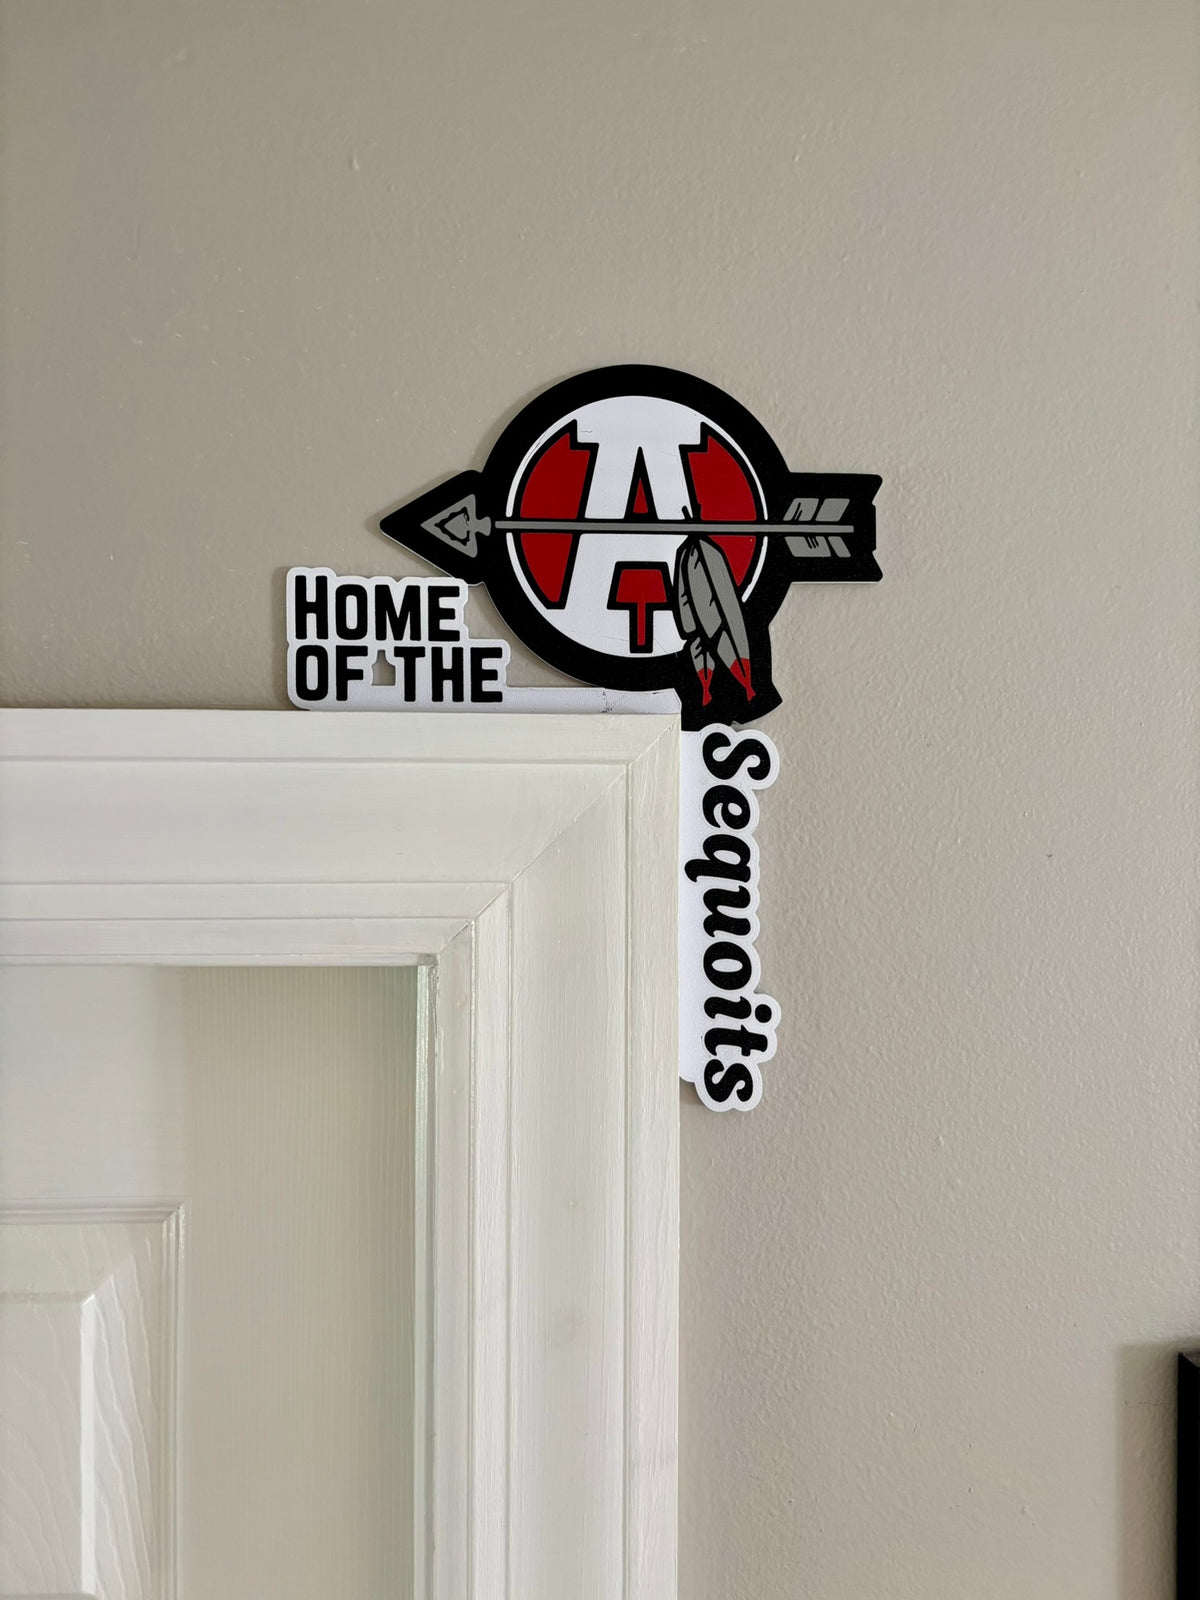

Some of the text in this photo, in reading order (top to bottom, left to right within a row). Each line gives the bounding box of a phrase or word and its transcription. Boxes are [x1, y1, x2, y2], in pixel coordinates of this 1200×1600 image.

[295, 575, 461, 642] HOME
[548, 396, 702, 658] A
[295, 645, 503, 703] OF THE
[684, 731, 772, 1103] Sequoits
